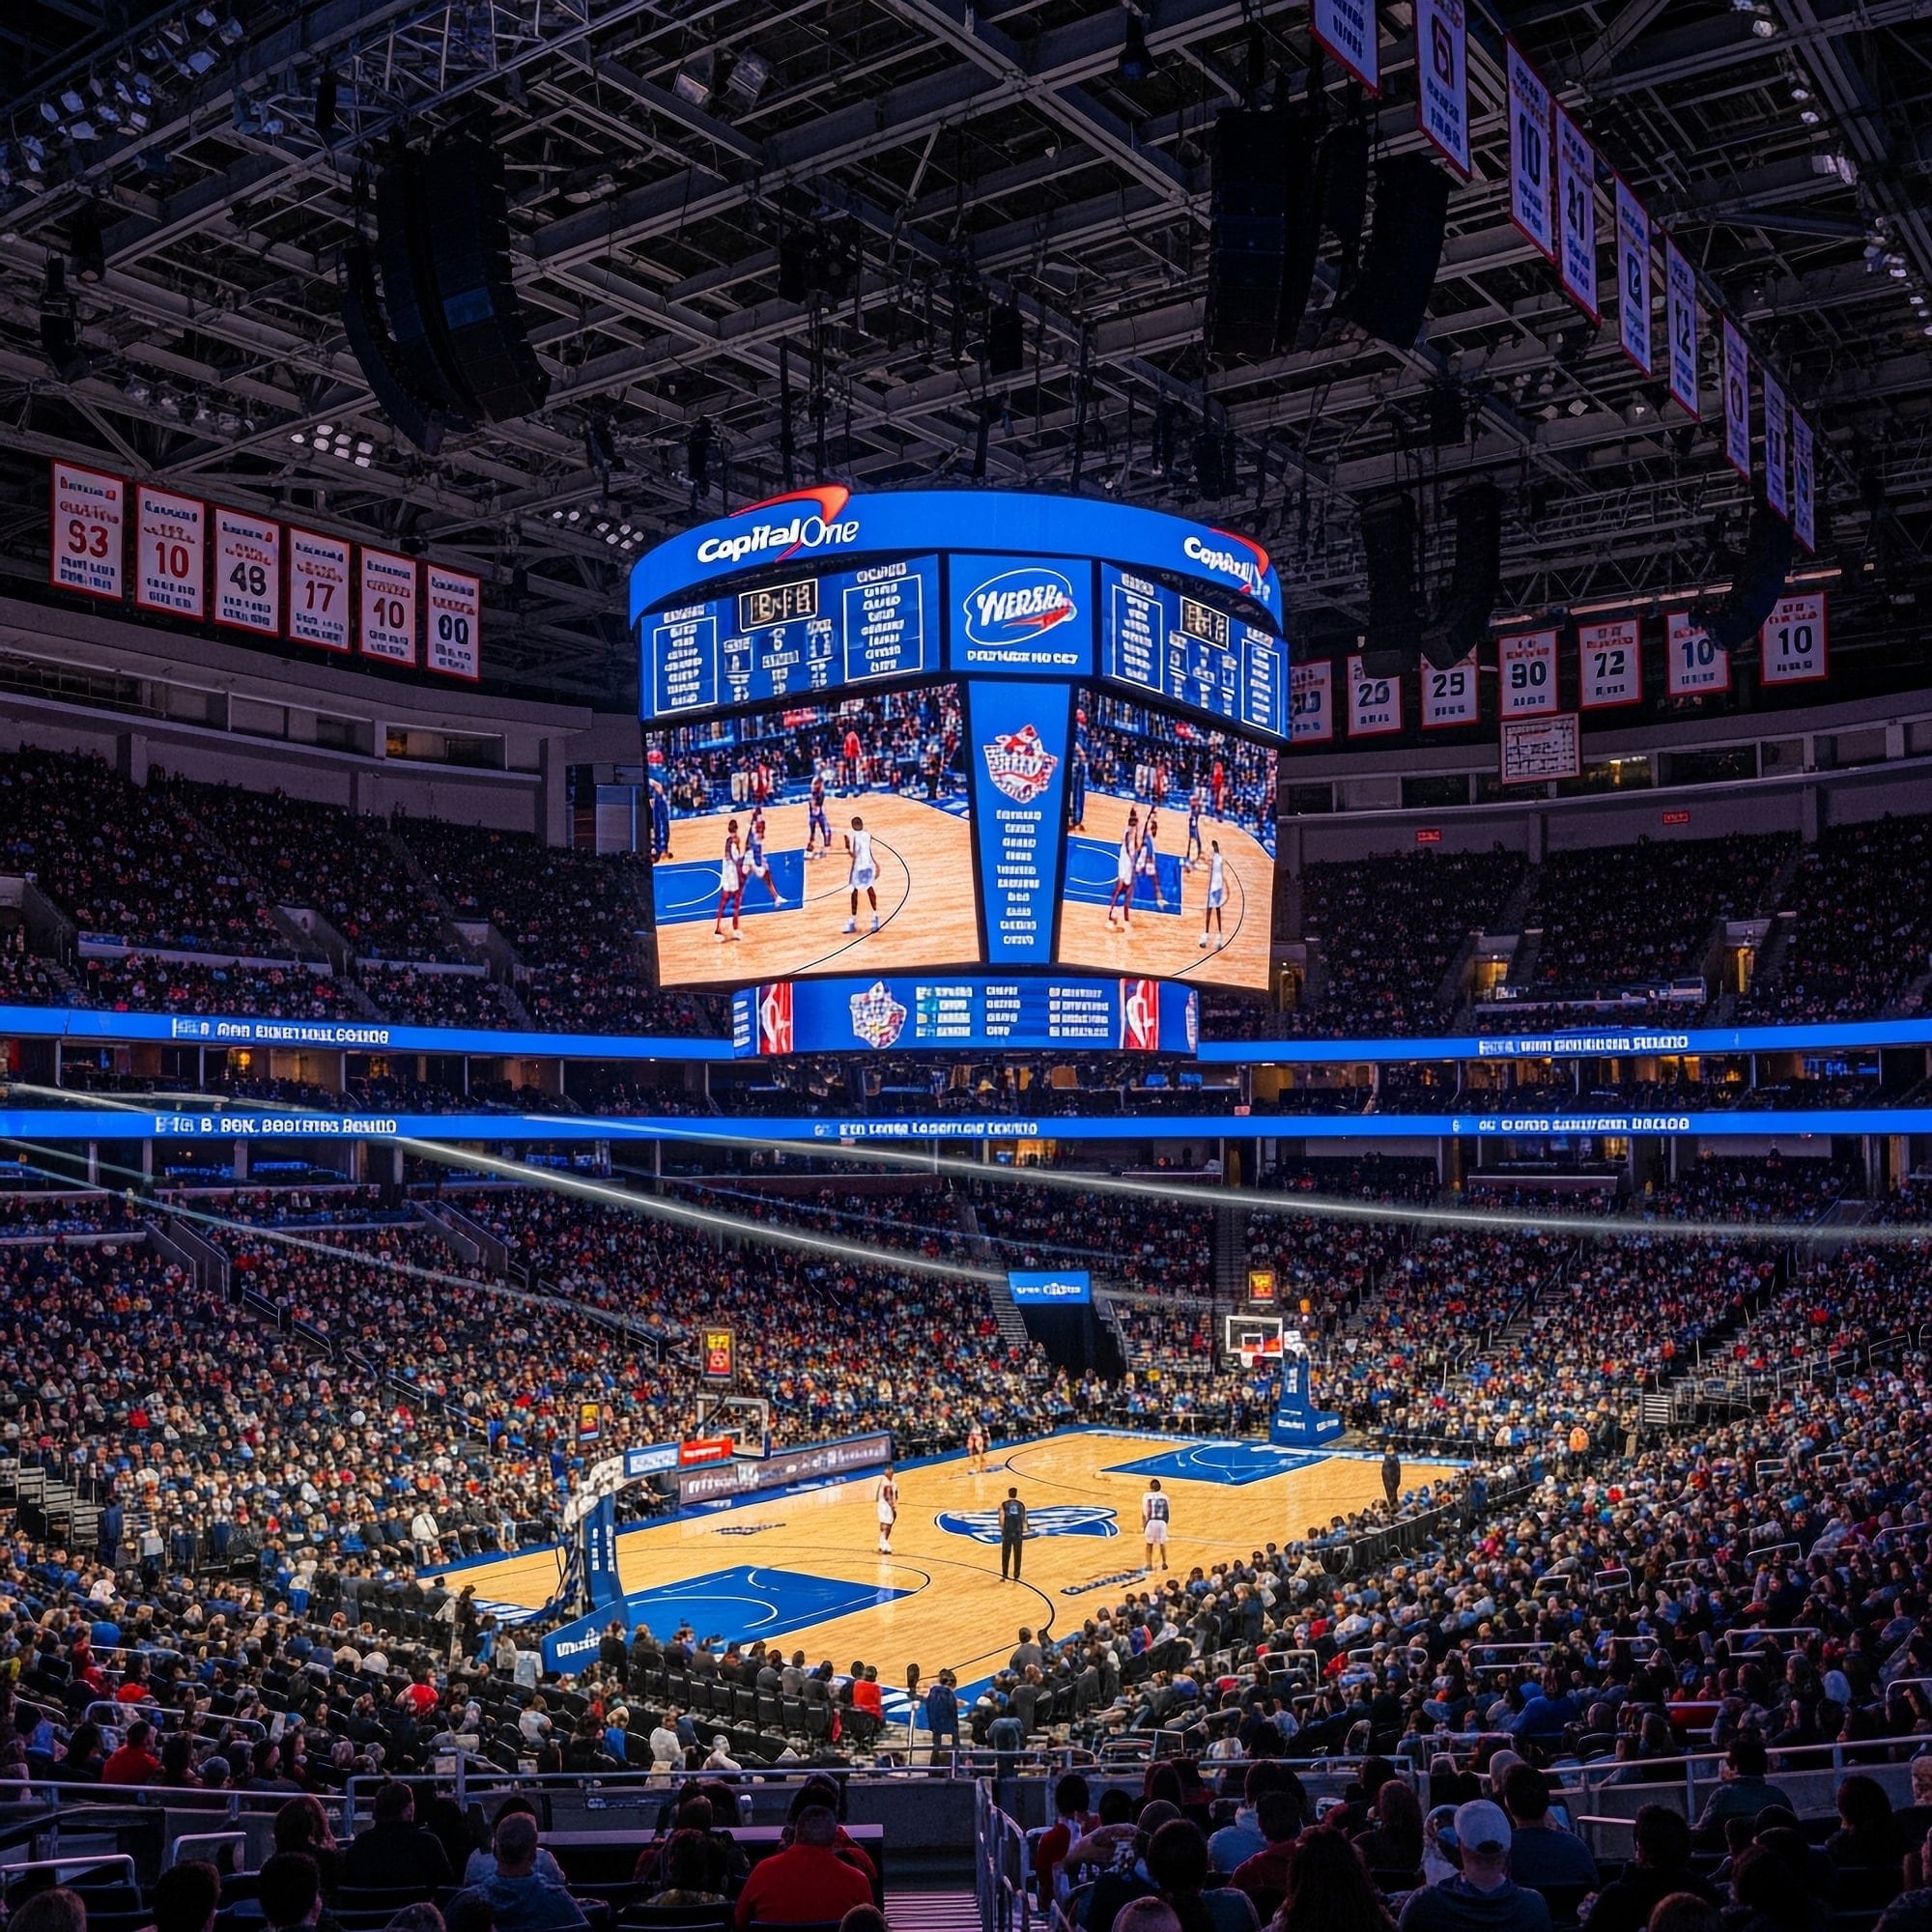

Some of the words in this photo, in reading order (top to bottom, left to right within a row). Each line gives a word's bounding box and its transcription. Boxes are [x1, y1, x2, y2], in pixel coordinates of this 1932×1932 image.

[155, 541, 189, 579] 10
[305, 580, 335, 612] 17
[373, 597, 405, 630] 10
[1681, 638, 1715, 668] 10
[1777, 625, 1813, 656] 10
